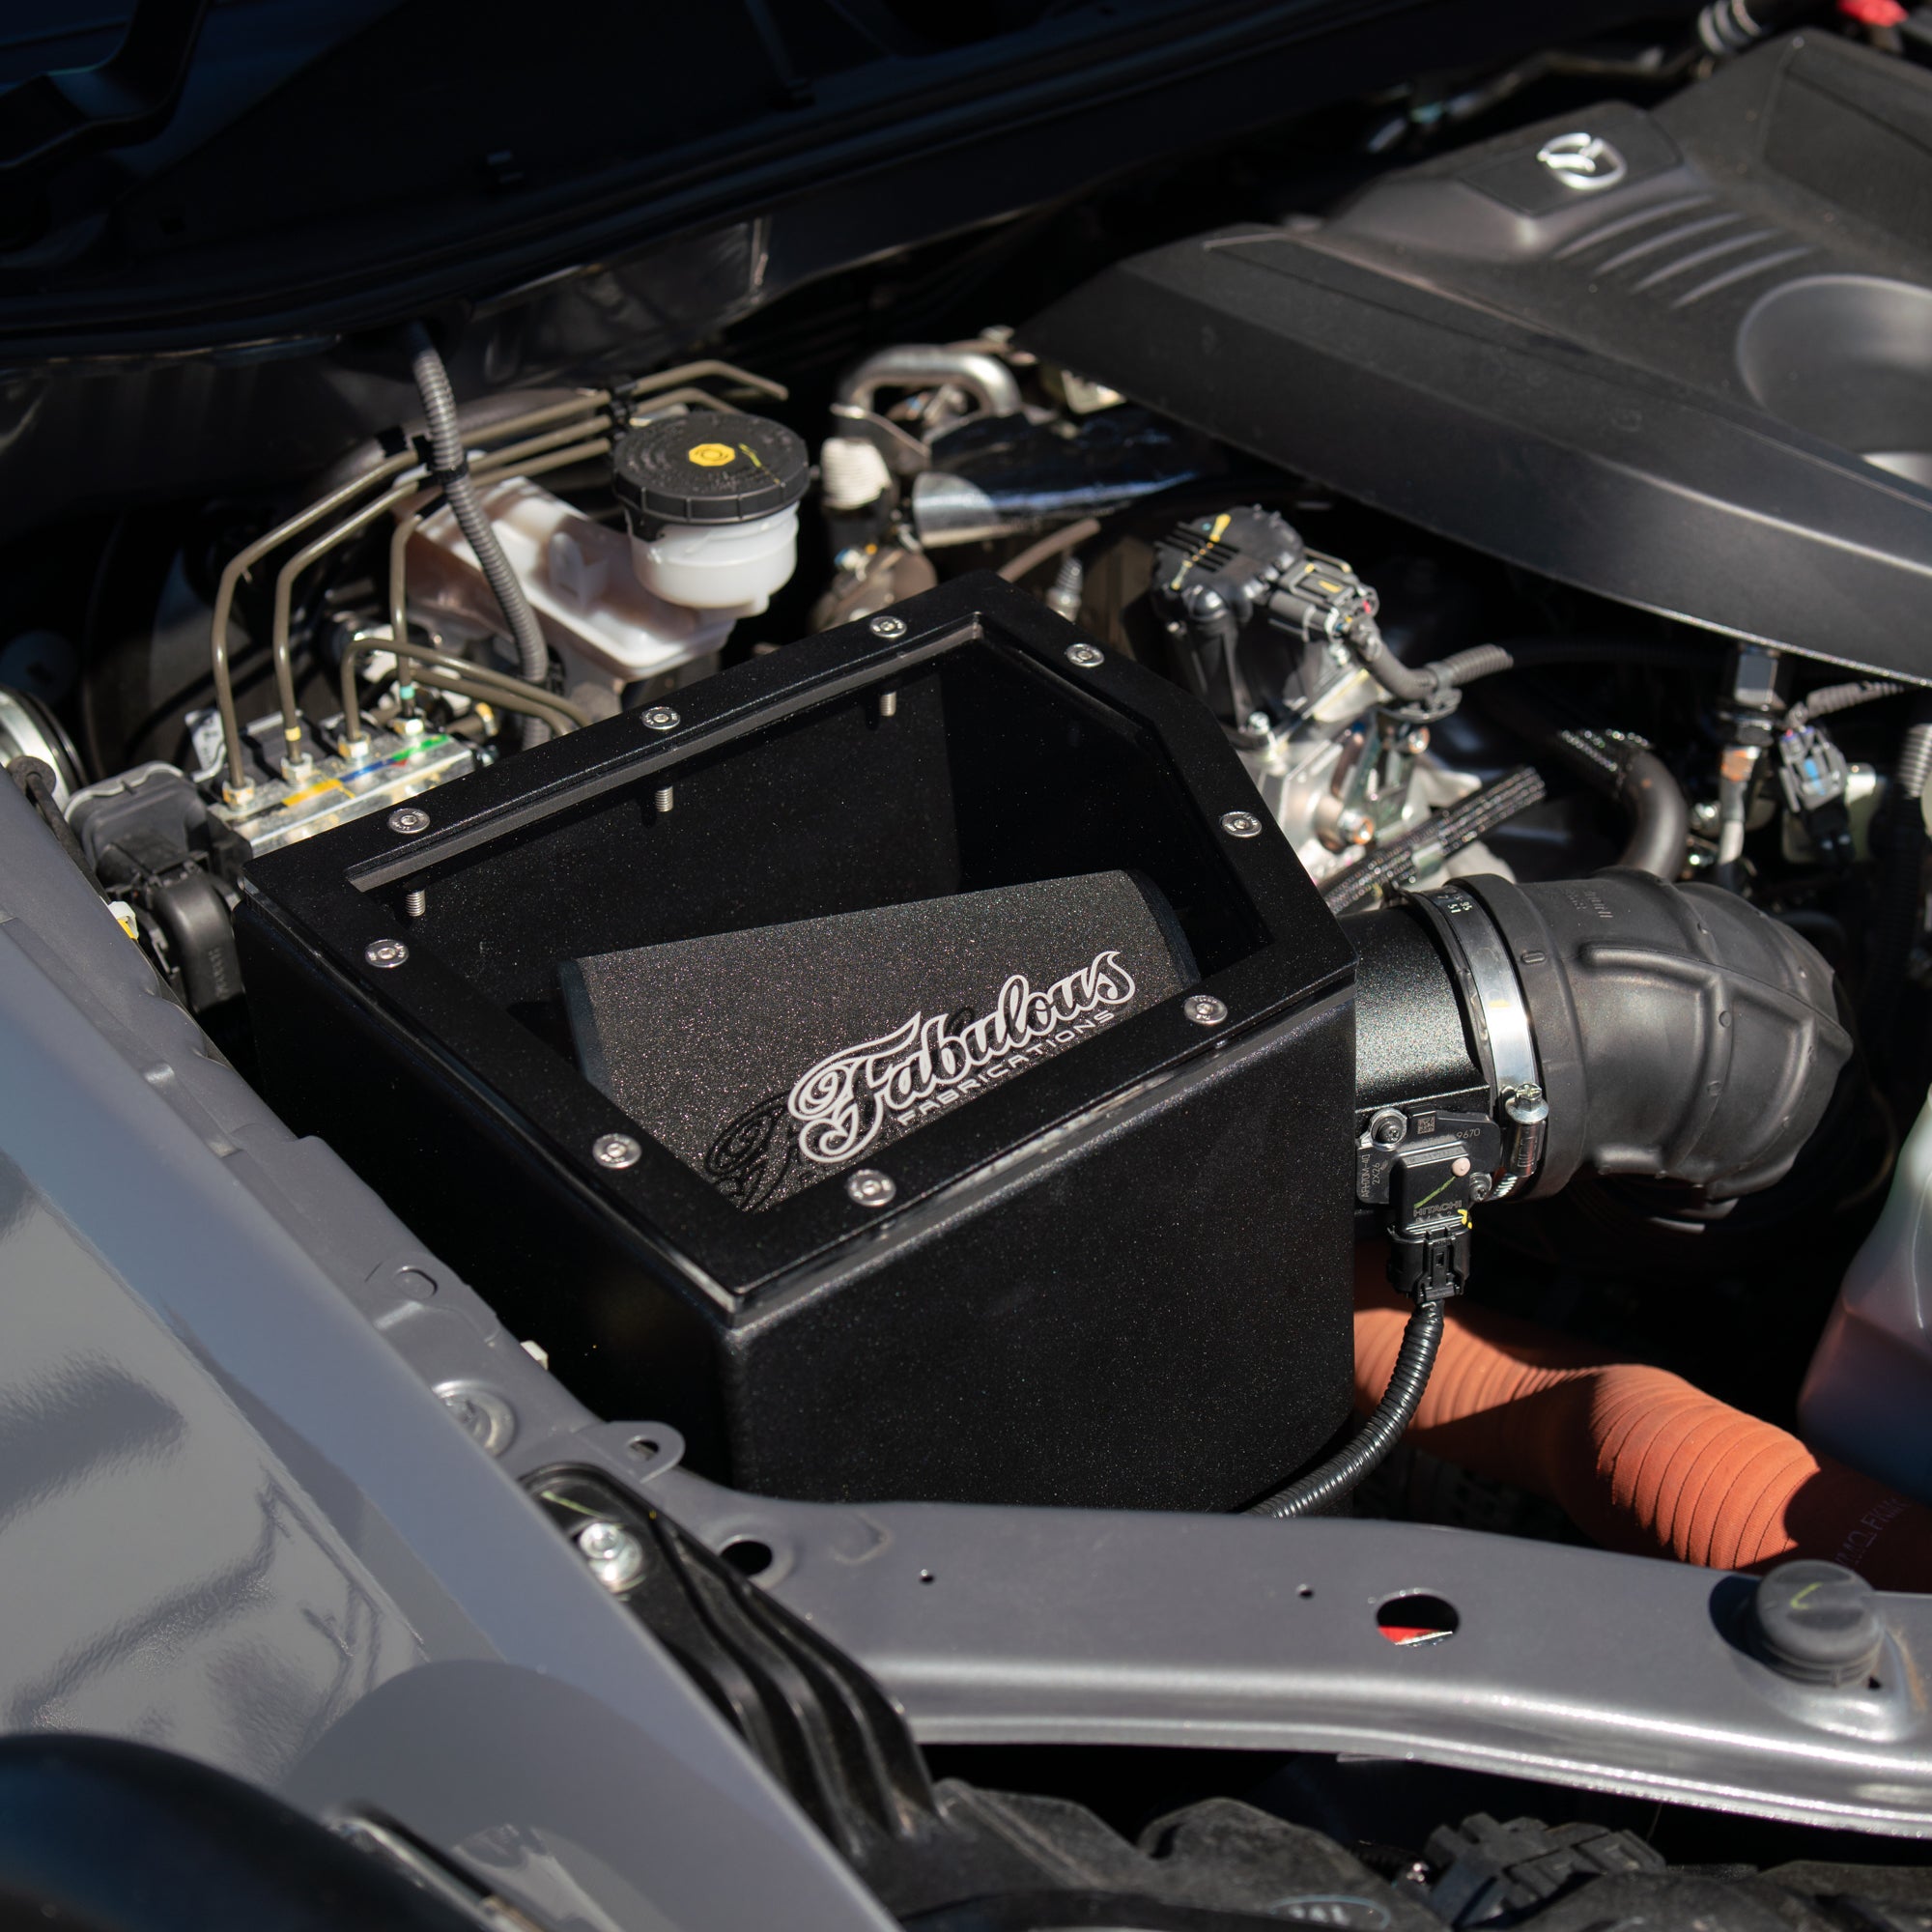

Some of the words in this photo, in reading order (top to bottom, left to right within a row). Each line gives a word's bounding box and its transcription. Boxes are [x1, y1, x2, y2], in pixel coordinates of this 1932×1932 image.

[787, 951, 1135, 1162] Fabulous
[896, 1012, 1115, 1127] FABRICATIONS
[1456, 1128, 1481, 1140] 9670
[1371, 1162, 1380, 1185] 2X26
[1412, 1199, 1463, 1218] HITACHI
